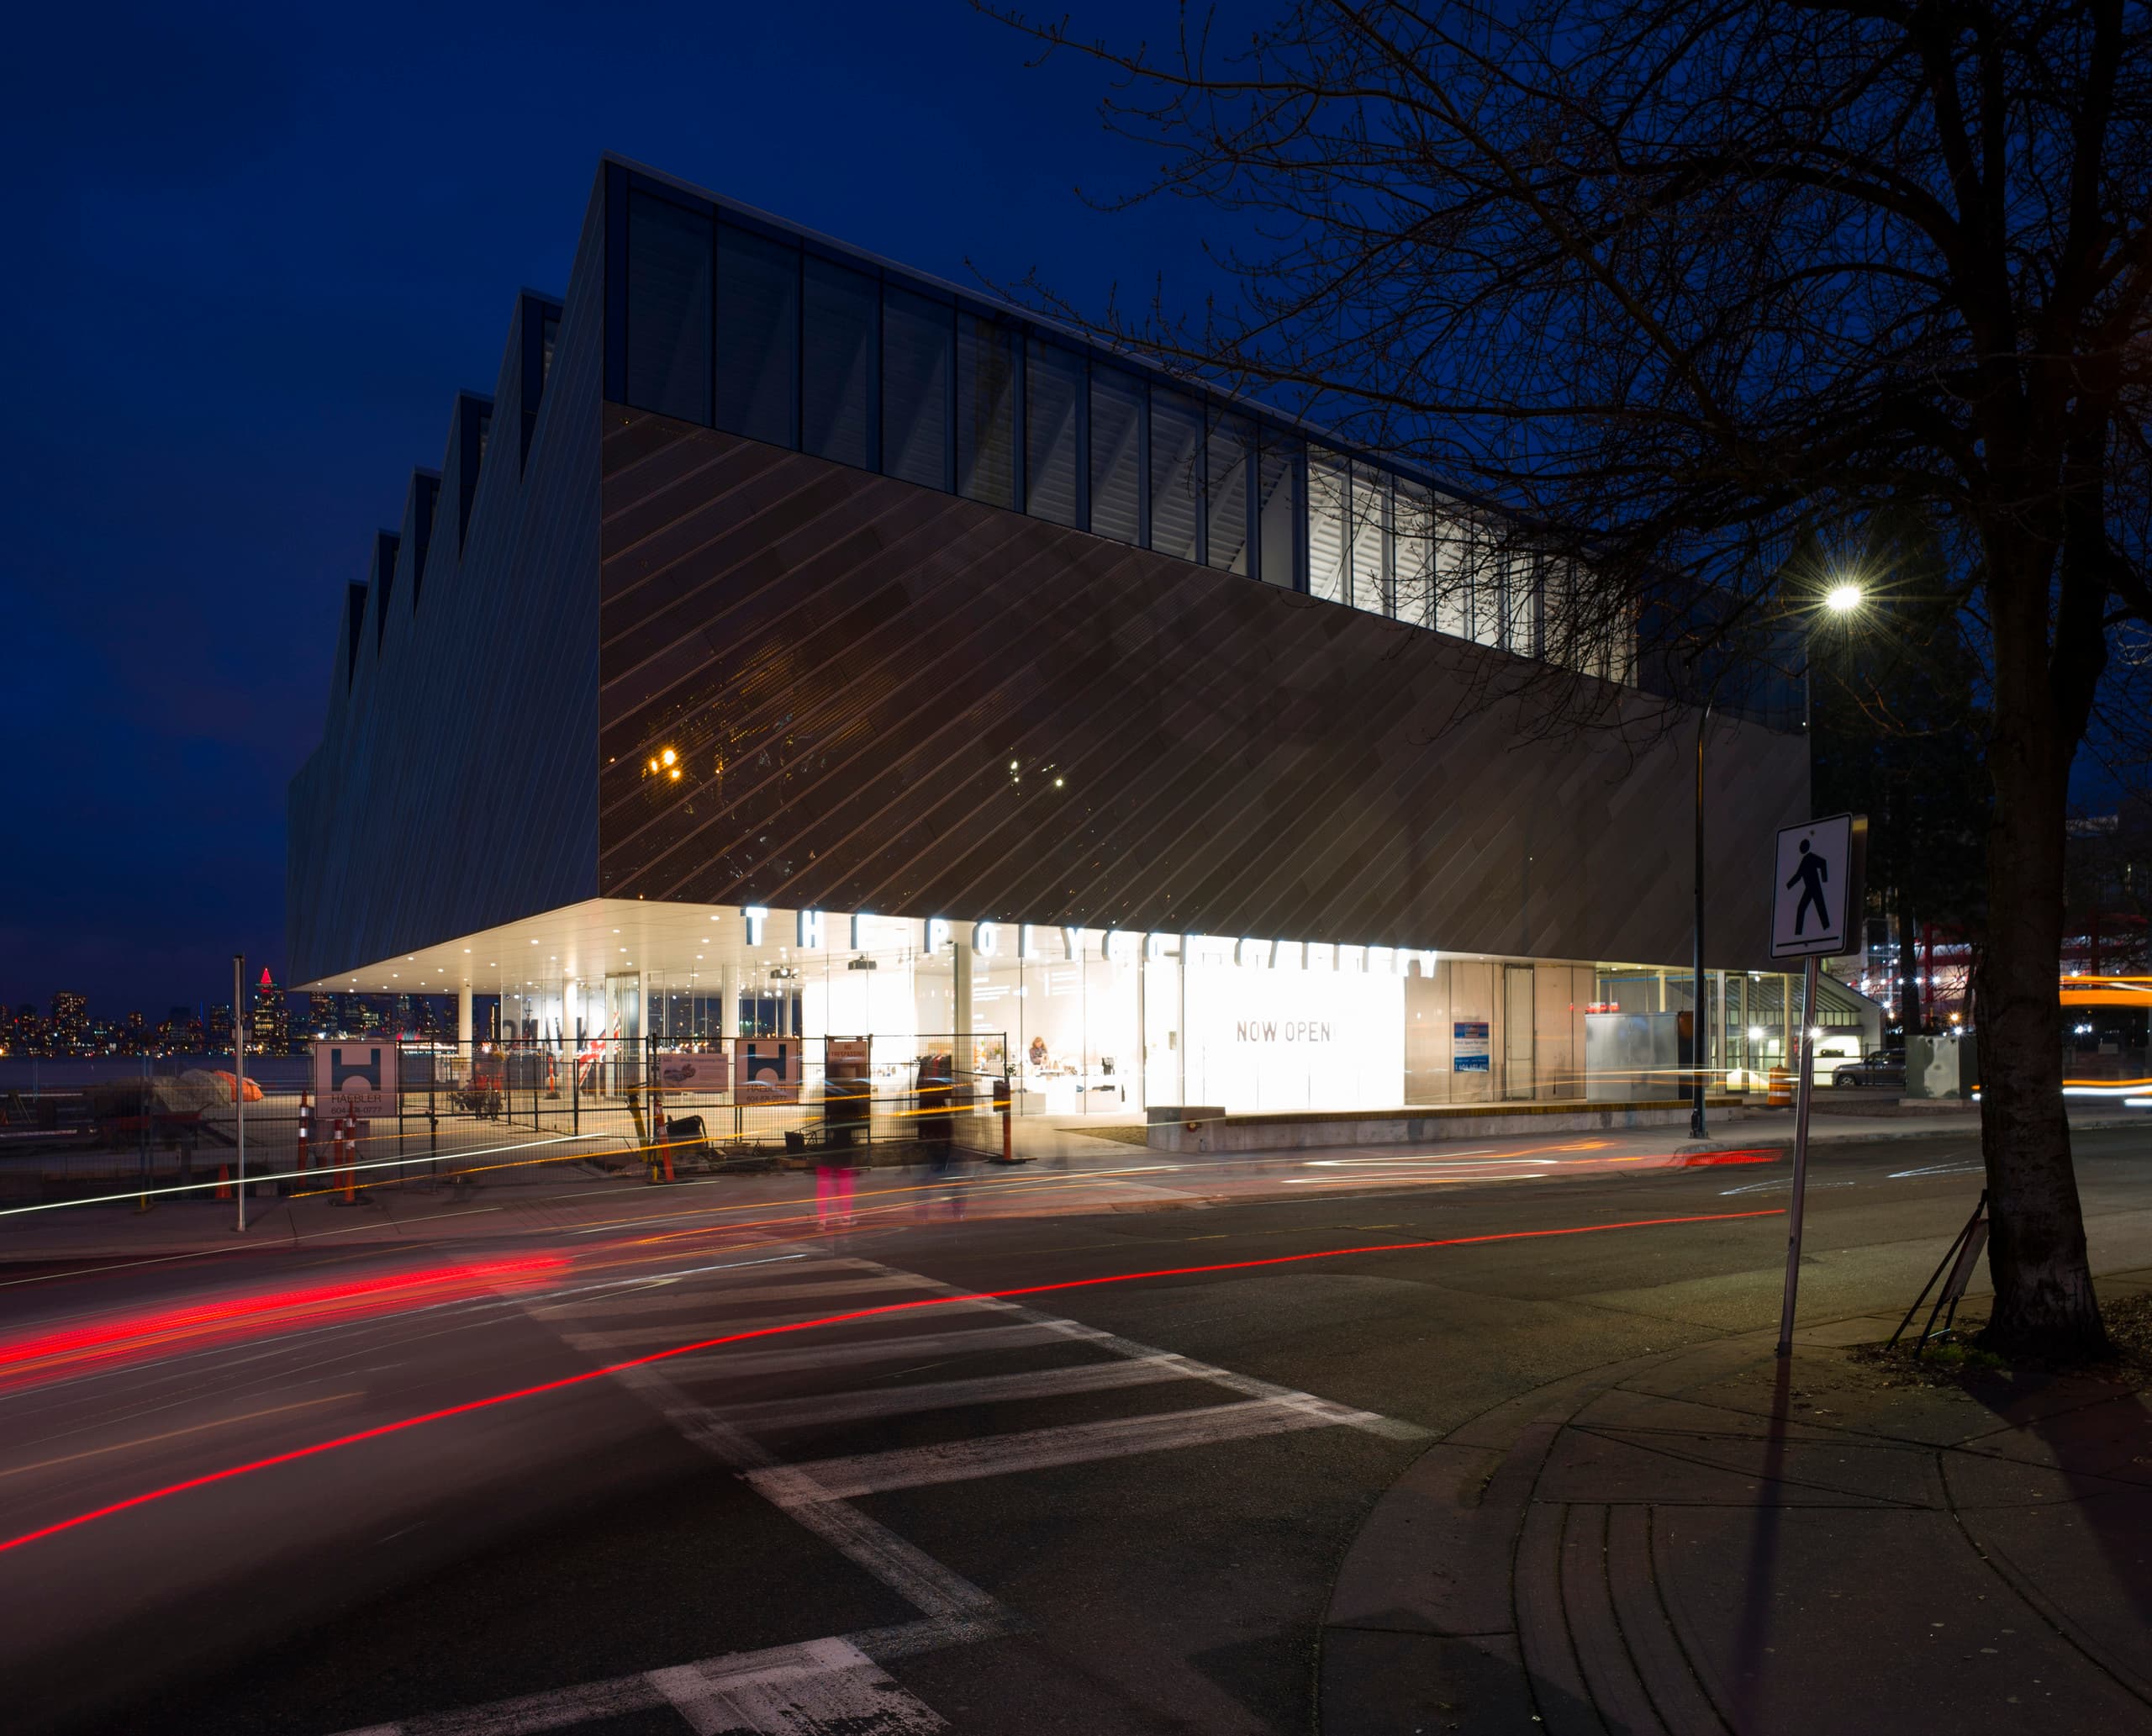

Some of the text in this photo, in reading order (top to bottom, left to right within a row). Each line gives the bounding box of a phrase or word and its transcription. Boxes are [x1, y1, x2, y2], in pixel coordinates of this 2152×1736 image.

[741, 906, 878, 950] THE
[1237, 1020, 1278, 1042] NOW
[331, 1094, 382, 1104] HAEBLER
